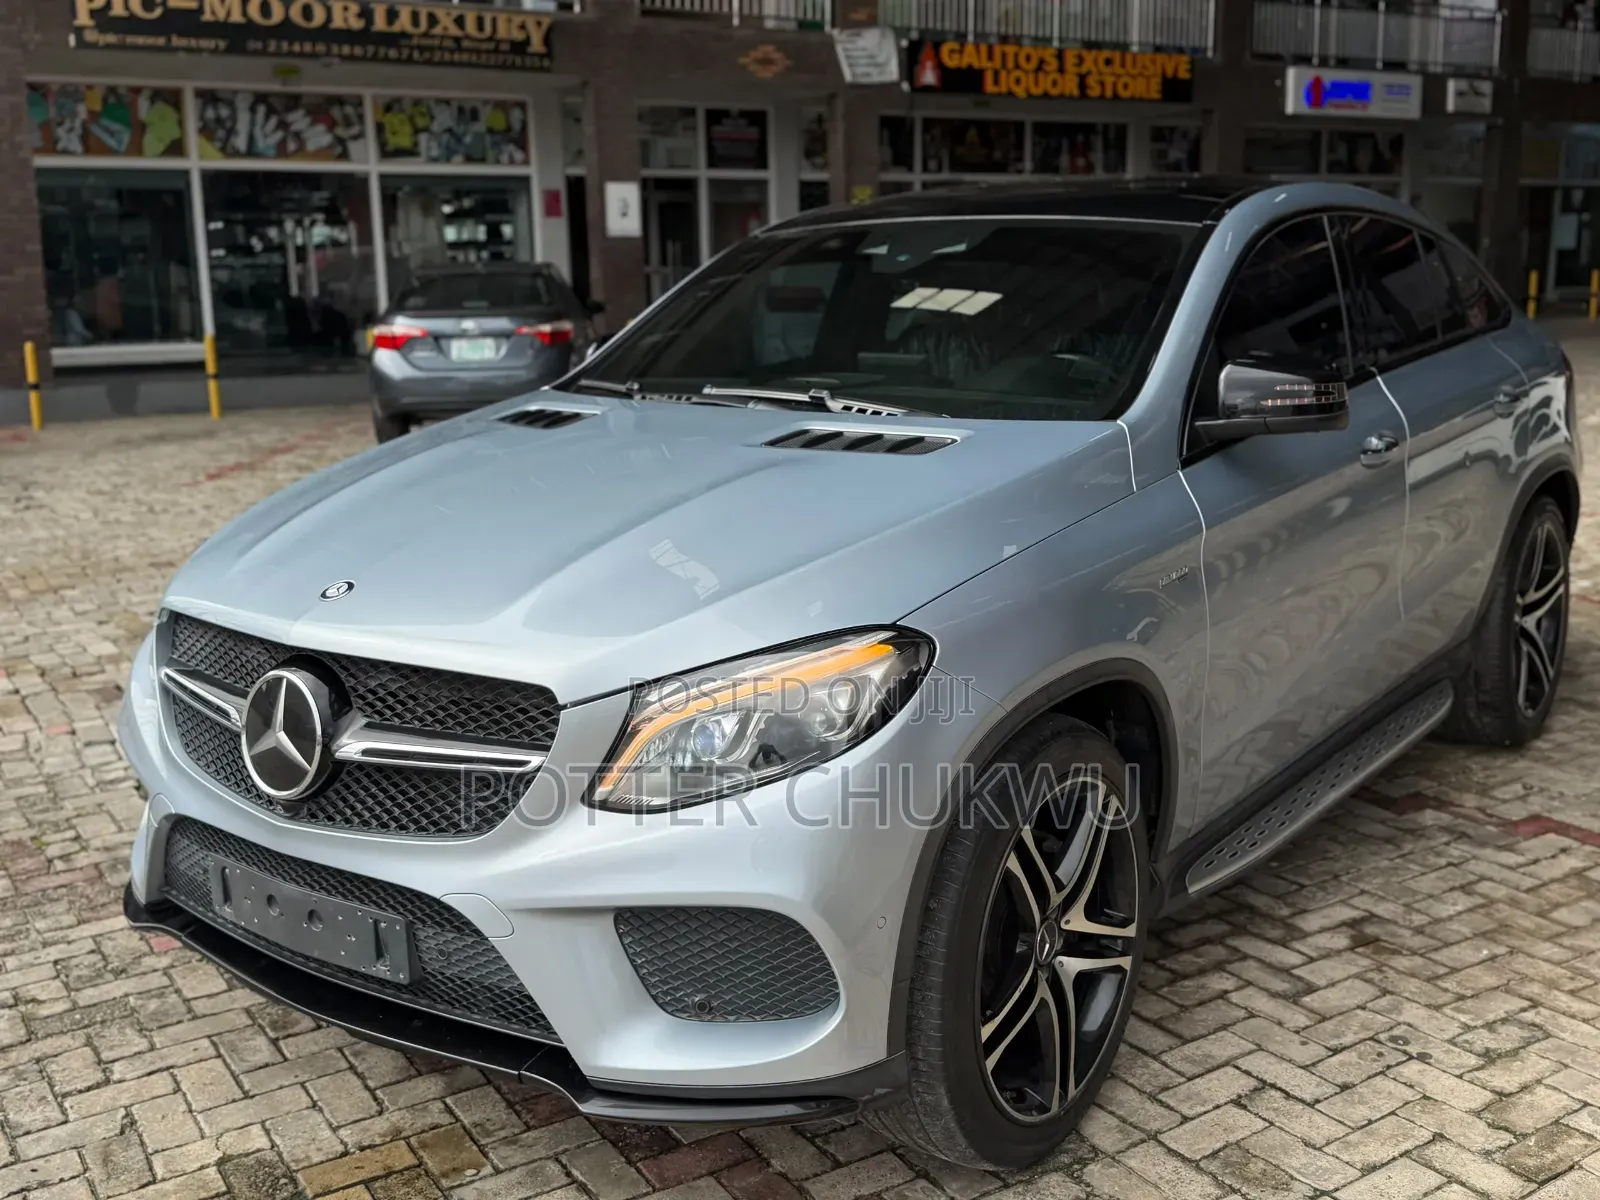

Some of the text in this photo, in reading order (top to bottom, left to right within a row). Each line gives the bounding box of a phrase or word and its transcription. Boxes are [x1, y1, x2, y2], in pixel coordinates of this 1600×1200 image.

[370, 1, 551, 54] LUXURY
[939, 41, 1193, 80] GALITO'S EXCLUSIVE
[982, 66, 1163, 101] LIQUOR STORE
